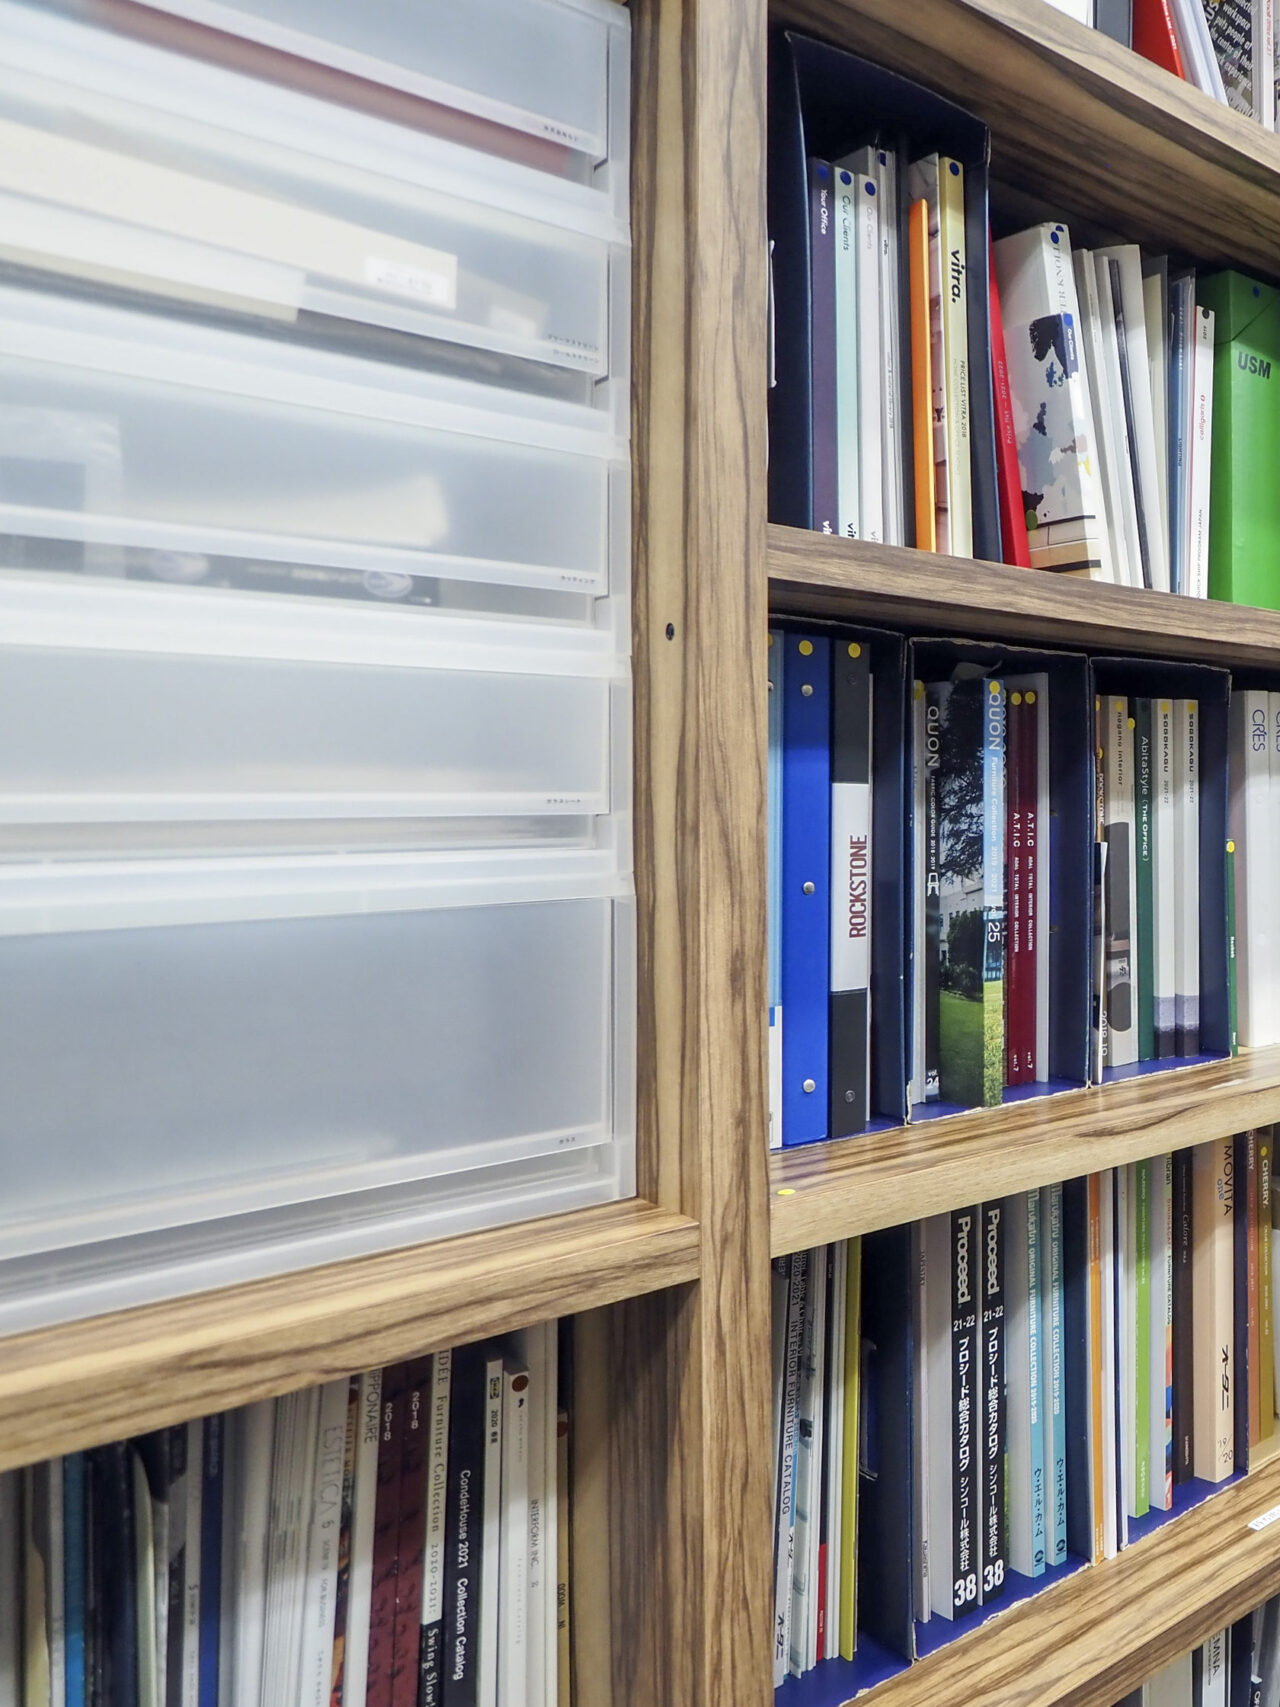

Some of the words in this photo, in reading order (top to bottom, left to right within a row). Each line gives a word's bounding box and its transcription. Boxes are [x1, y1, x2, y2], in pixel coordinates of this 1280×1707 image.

[1222, 3, 1250, 31] workspace
[1227, 22, 1249, 43] people
[1216, 34, 1235, 56] center
[820, 189, 828, 208] Your
[842, 194, 852, 214] Our
[866, 206, 874, 224] Our
[820, 209, 829, 236] Office
[842, 216, 852, 252] Clients
[866, 225, 874, 250] Clients
[950, 249, 966, 304] vitra.
[1238, 351, 1272, 380] USM
[1004, 424, 1012, 444] Price
[1199, 403, 1207, 441] calligaris
[927, 705, 940, 768] QUON
[988, 692, 1001, 751] QUON
[990, 756, 998, 796] Furniture
[1140, 735, 1150, 795] AbitaStyle
[990, 797, 998, 842] Collection
[1027, 811, 1035, 847] A.T.I.C
[849, 834, 868, 938] ROCKSTONE
[988, 921, 1000, 943] 25
[926, 1077, 940, 1088] 24
[1217, 1178, 1225, 1200] one
[1223, 1145, 1233, 1216] MOVITA
[957, 1215, 971, 1305] Proceed
[987, 1207, 1000, 1297] Proceed
[1028, 1247, 1036, 1287] ORIGINAL
[791, 1250, 801, 1307] 2020-2021
[952, 1314, 976, 1333] 21-22
[983, 1305, 1004, 1323] 21-22
[1029, 1289, 1037, 1335] FURNITURE
[1052, 1283, 1060, 1328] FURNITURE
[788, 1319, 798, 1378] INTERIOR
[1030, 1337, 1038, 1386] COLLECTION
[411, 1391, 420, 1430] 2018
[958, 1336, 971, 1473] プロシード総合カタログ
[987, 1327, 1000, 1461] プロシード総合カタログ
[383, 1403, 393, 1442] 2018
[433, 1395, 447, 1458] Furniture
[490, 1409, 498, 1430] 2020
[785, 1380, 797, 1450] FURNITURE
[1223, 1450, 1233, 1464] 20
[431, 1463, 445, 1533] Collection
[782, 1453, 793, 1516] CATALOG
[458, 1469, 472, 1541] CondeHouse
[958, 1476, 971, 1572] シンコール株式会社
[987, 1463, 999, 1558] シンコール株式会社
[458, 1543, 470, 1569] 2021
[982, 1558, 1005, 1593] 38
[455, 1577, 469, 1634] Collection
[953, 1573, 977, 1607] 38
[425, 1627, 439, 1670] Swing
[453, 1636, 468, 1681] Catalog
